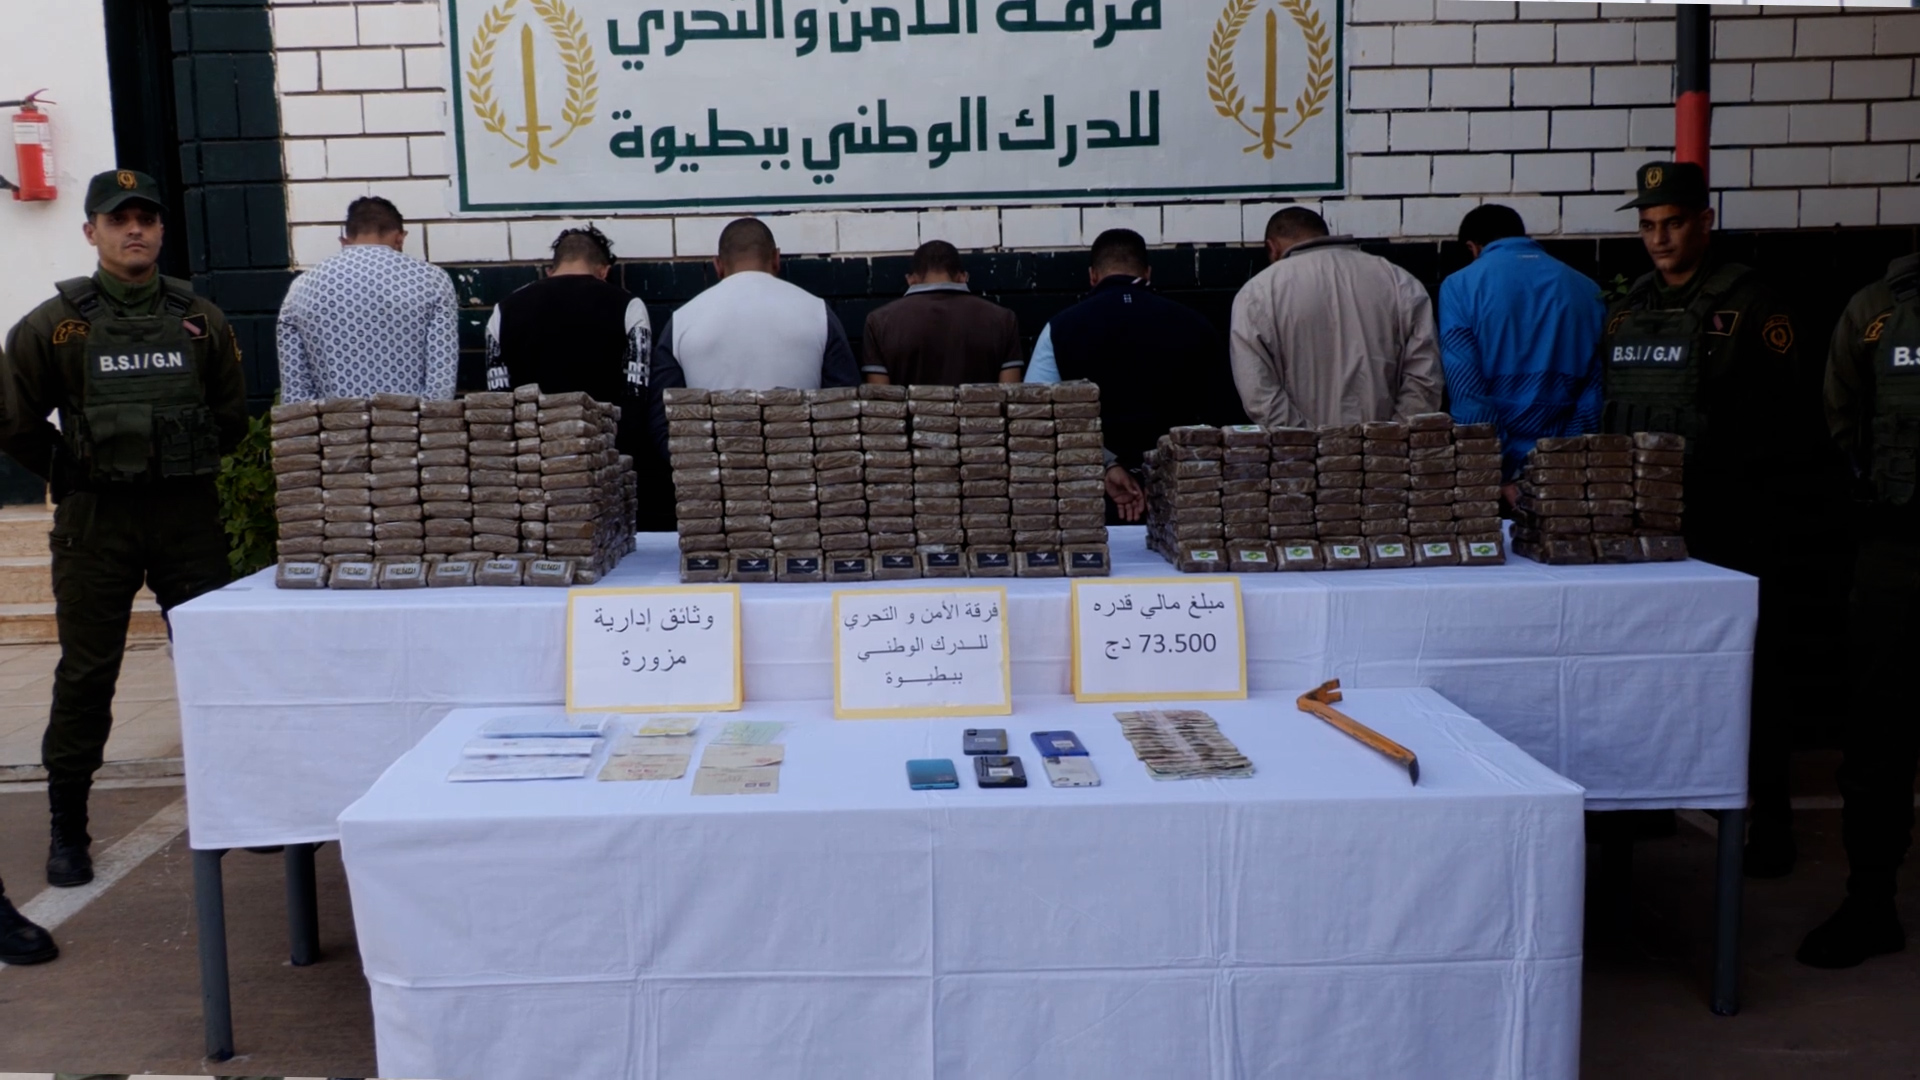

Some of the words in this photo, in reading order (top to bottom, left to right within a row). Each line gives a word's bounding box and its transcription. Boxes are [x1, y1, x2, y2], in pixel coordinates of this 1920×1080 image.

[802, 95, 988, 185] الوطني
[998, 89, 1160, 168] للدرك
[609, 108, 791, 174] ببطيوة
[921, 600, 959, 624] الأمن
[965, 602, 998, 622] فرقة
[1093, 594, 1133, 617] قدره
[1140, 593, 1180, 619] مالي
[1188, 593, 1225, 619] مبلغ
[594, 607, 651, 632] إدارية
[660, 605, 714, 631] وثائق
[844, 606, 898, 630] التحري
[906, 612, 915, 624] و
[1105, 637, 1131, 660] دج
[1138, 633, 1217, 653] 73.500
[622, 649, 687, 672] مزورة
